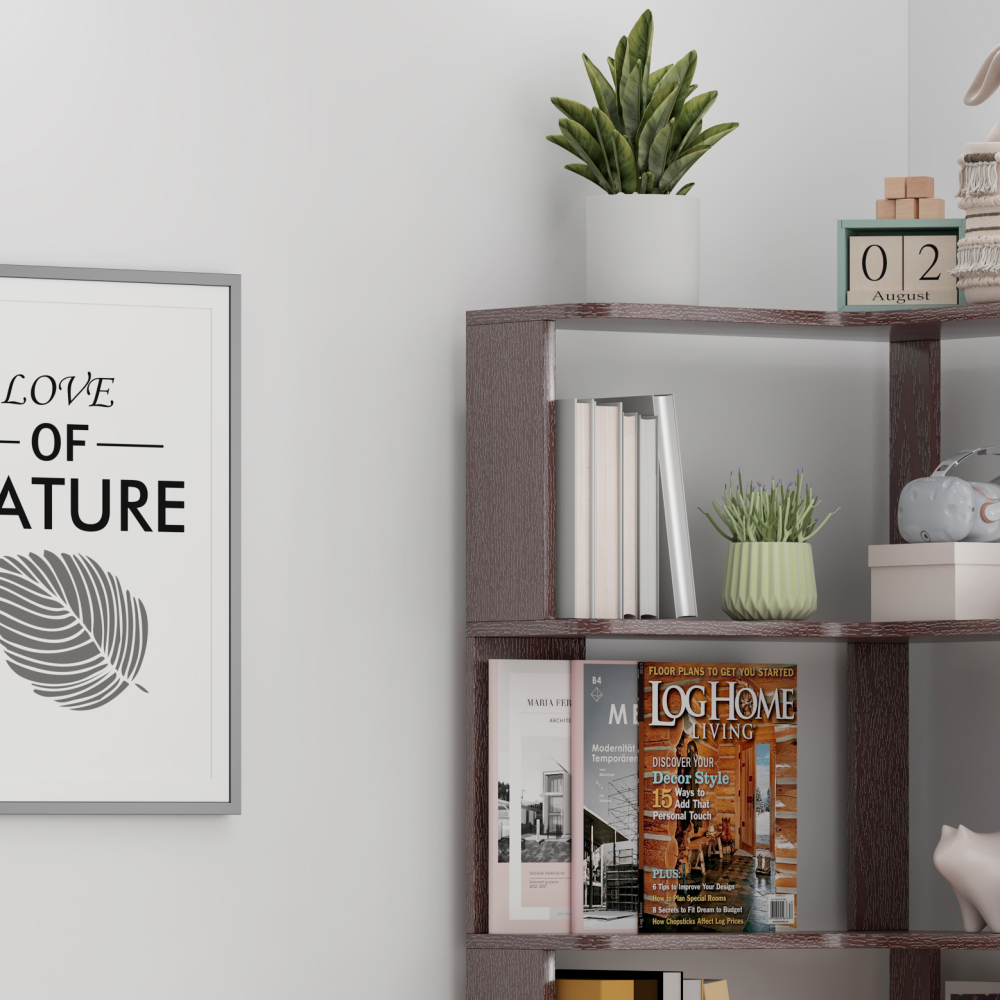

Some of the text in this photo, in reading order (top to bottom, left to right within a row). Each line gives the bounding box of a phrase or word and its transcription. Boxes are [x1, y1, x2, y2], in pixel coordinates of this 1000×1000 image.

[872, 291, 930, 304] August
[1, 372, 115, 408] LOVE
[31, 422, 89, 462] OF
[0, 475, 185, 533] ATURE
[649, 666, 675, 675] FLOOR
[678, 667, 704, 676] PLANS
[708, 667, 718, 676] TO
[721, 667, 736, 676] GET
[739, 668, 755, 677] YOU
[758, 668, 794, 677] STARTED
[592, 676, 602, 684] B4
[527, 699, 553, 707] MARIA
[692, 723, 754, 740] LIVING
[592, 744, 635, 752] Modernität
[652, 757, 714, 768] DISCOVER YOUR
[652, 771, 729, 788] Decor Style
[652, 788, 673, 808] 15
[675, 787, 705, 798] Ways to
[674, 799, 710, 808] Add That
[652, 811, 712, 820] Personal Touch
[652, 869, 681, 879] PLUS:
[716, 883, 735, 891] Design
[723, 906, 742, 914] Budget
